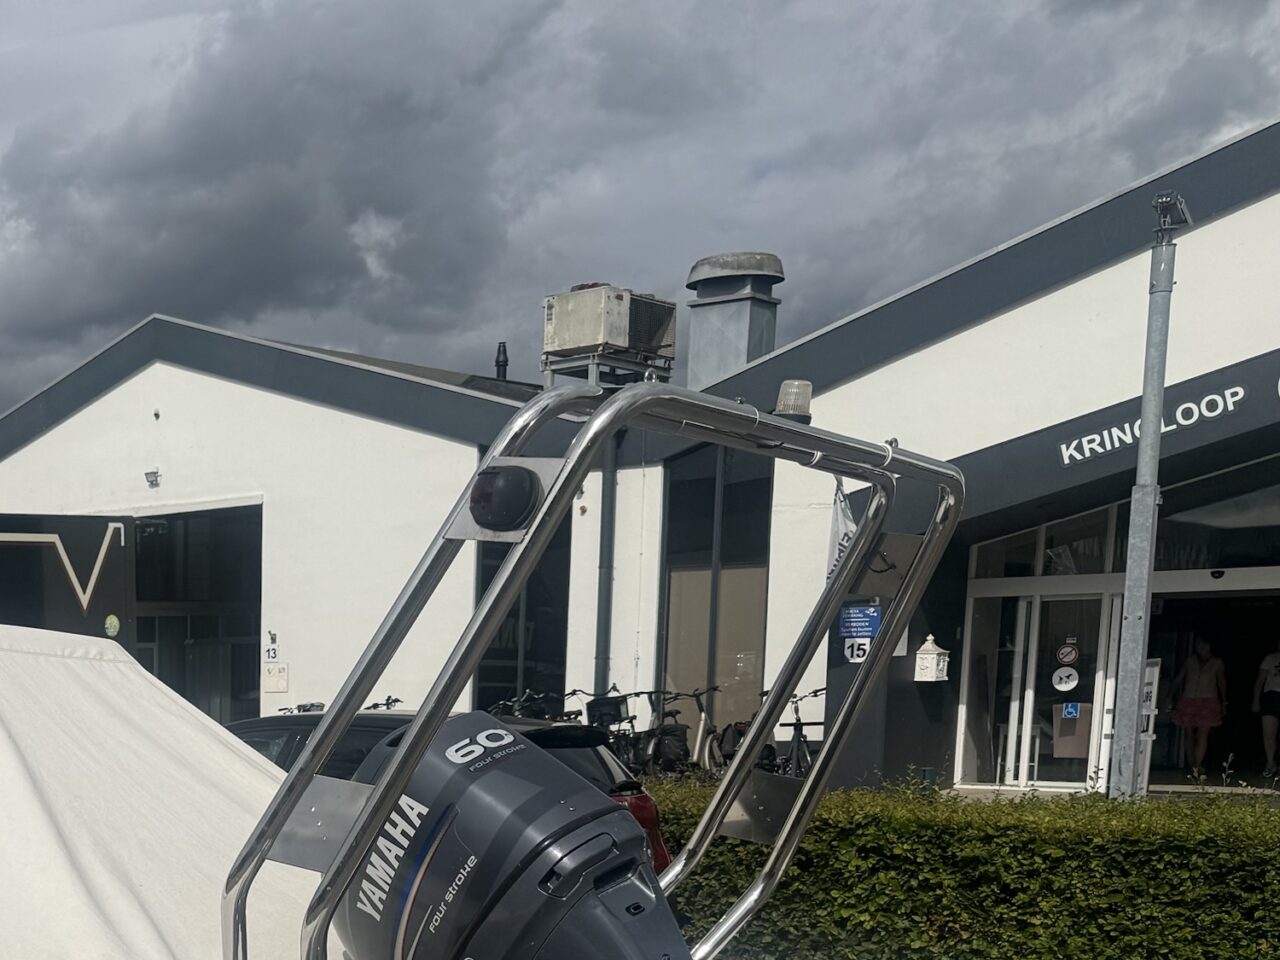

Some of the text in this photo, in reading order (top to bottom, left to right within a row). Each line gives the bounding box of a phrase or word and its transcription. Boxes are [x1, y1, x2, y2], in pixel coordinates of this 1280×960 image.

[265, 648, 277, 659] 13
[847, 643, 867, 659] 15
[445, 728, 515, 764] 60
[356, 793, 429, 922] YAMAHA
